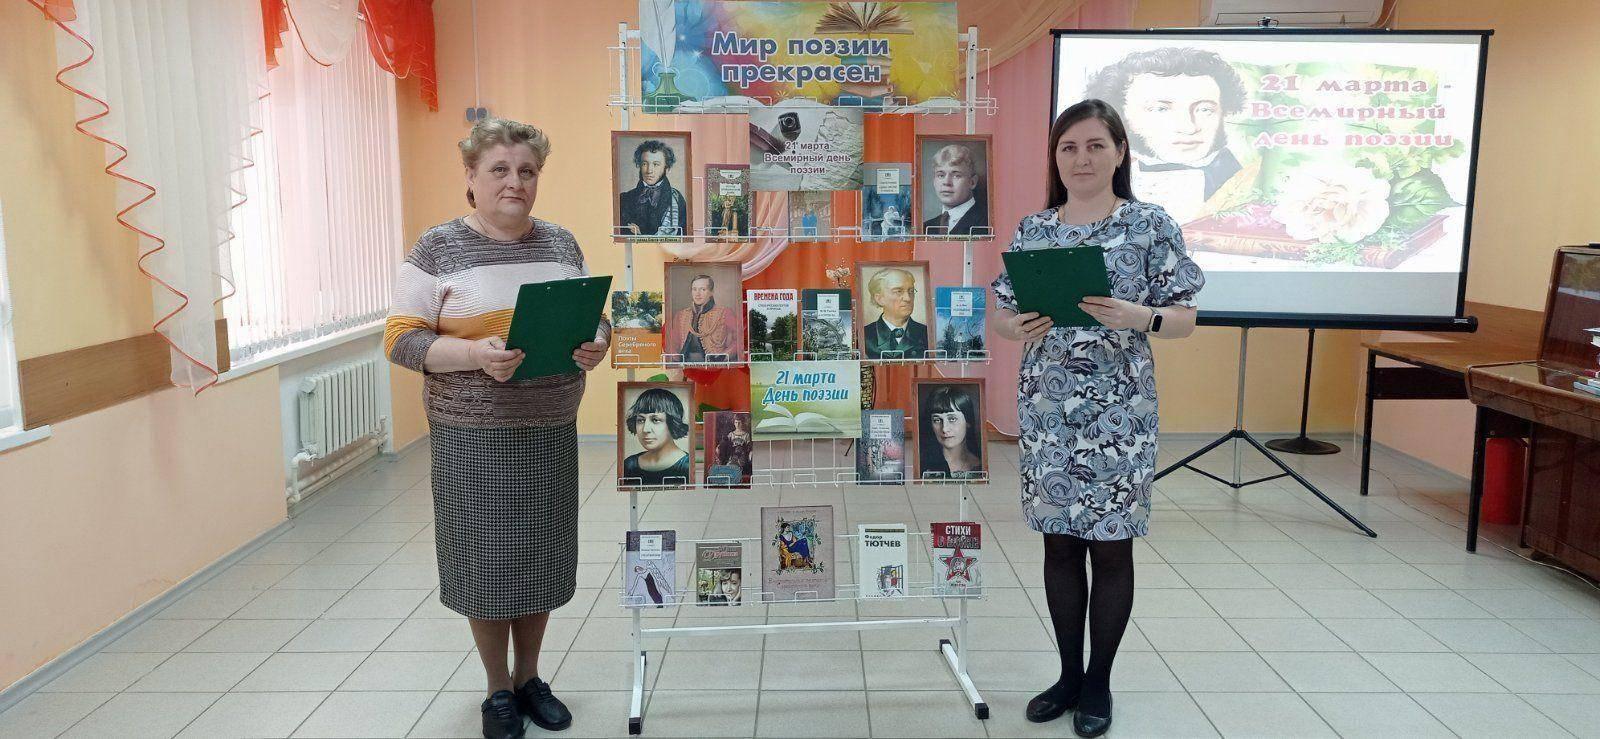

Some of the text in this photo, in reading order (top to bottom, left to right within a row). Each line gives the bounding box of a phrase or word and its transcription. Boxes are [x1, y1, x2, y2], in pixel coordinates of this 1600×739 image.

[713, 32, 889, 61] Мир поэзии
[722, 64, 881, 88] прекрасен
[1261, 75, 1299, 91] 21
[1315, 78, 1428, 94] марта
[1251, 102, 1446, 121] Всемирный
[785, 141, 830, 151] 21 марта
[1254, 132, 1453, 147] день поэзии
[764, 153, 851, 163] Всемирный день
[776, 370, 836, 386] 21 марта
[762, 387, 849, 404] День поэзии
[945, 525, 971, 535] СТИХИ
